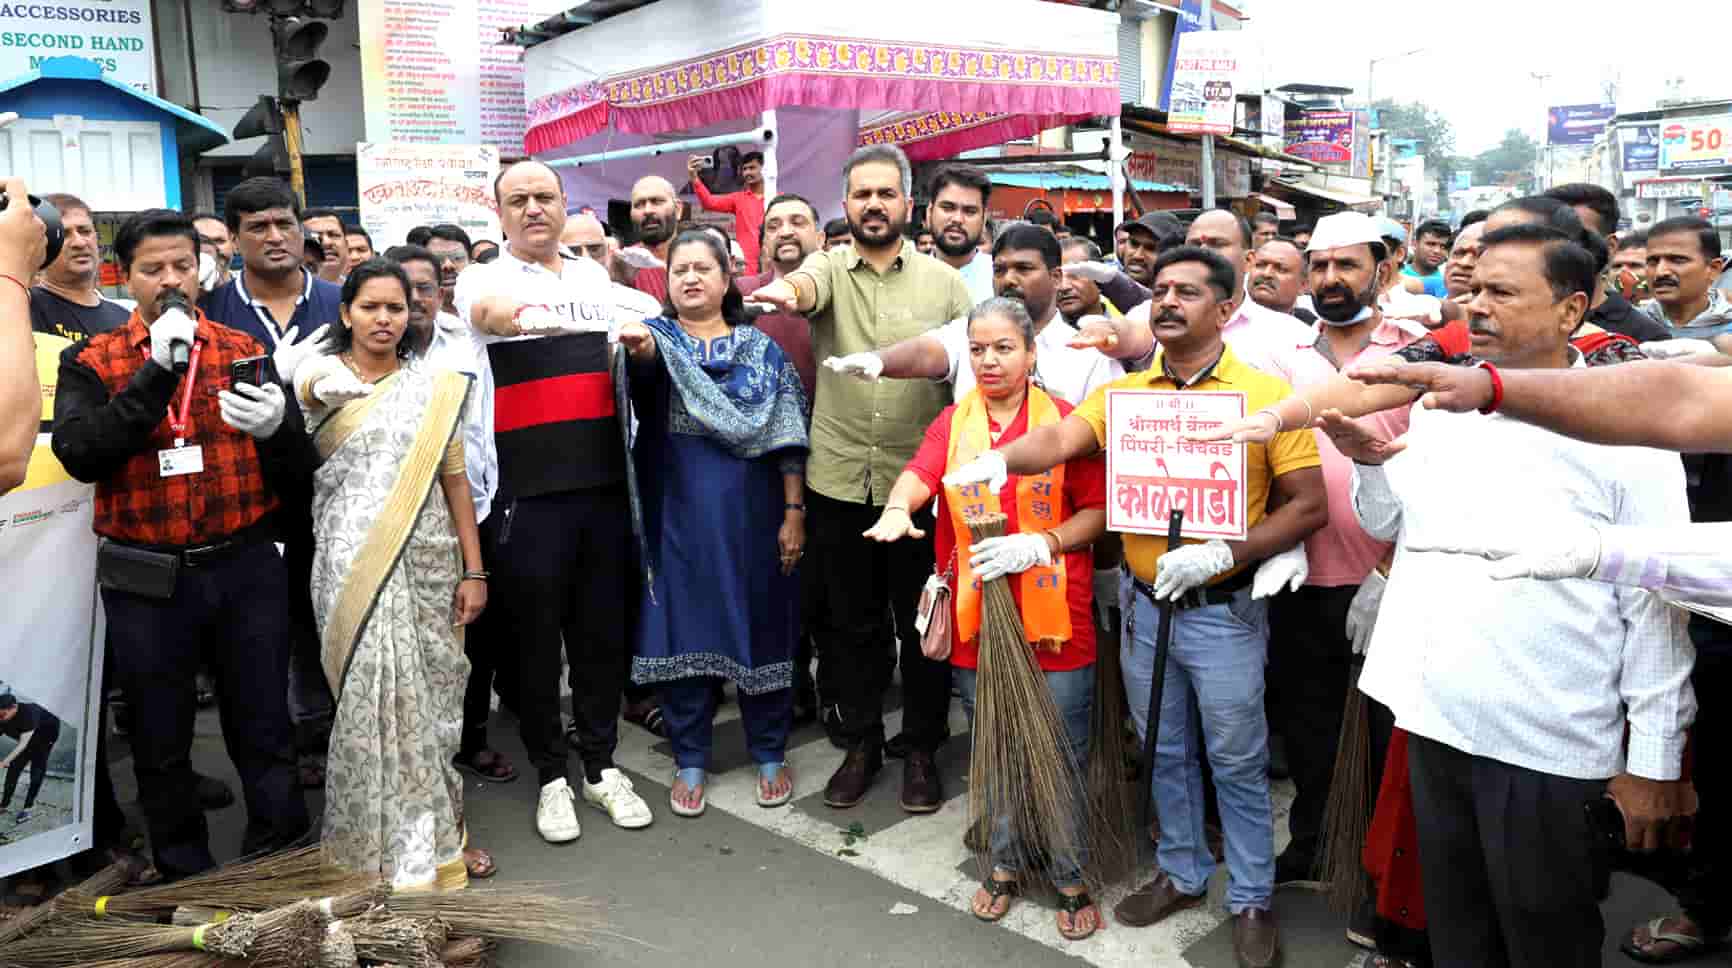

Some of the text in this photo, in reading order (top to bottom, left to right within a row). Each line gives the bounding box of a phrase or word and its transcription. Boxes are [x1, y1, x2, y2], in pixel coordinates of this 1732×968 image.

[0, 4, 142, 25] ACCESSORIES
[2, 32, 144, 52] SECOND HAND
[1690, 128, 1723, 151] 50
[1115, 457, 1238, 526] काळेवाडी
